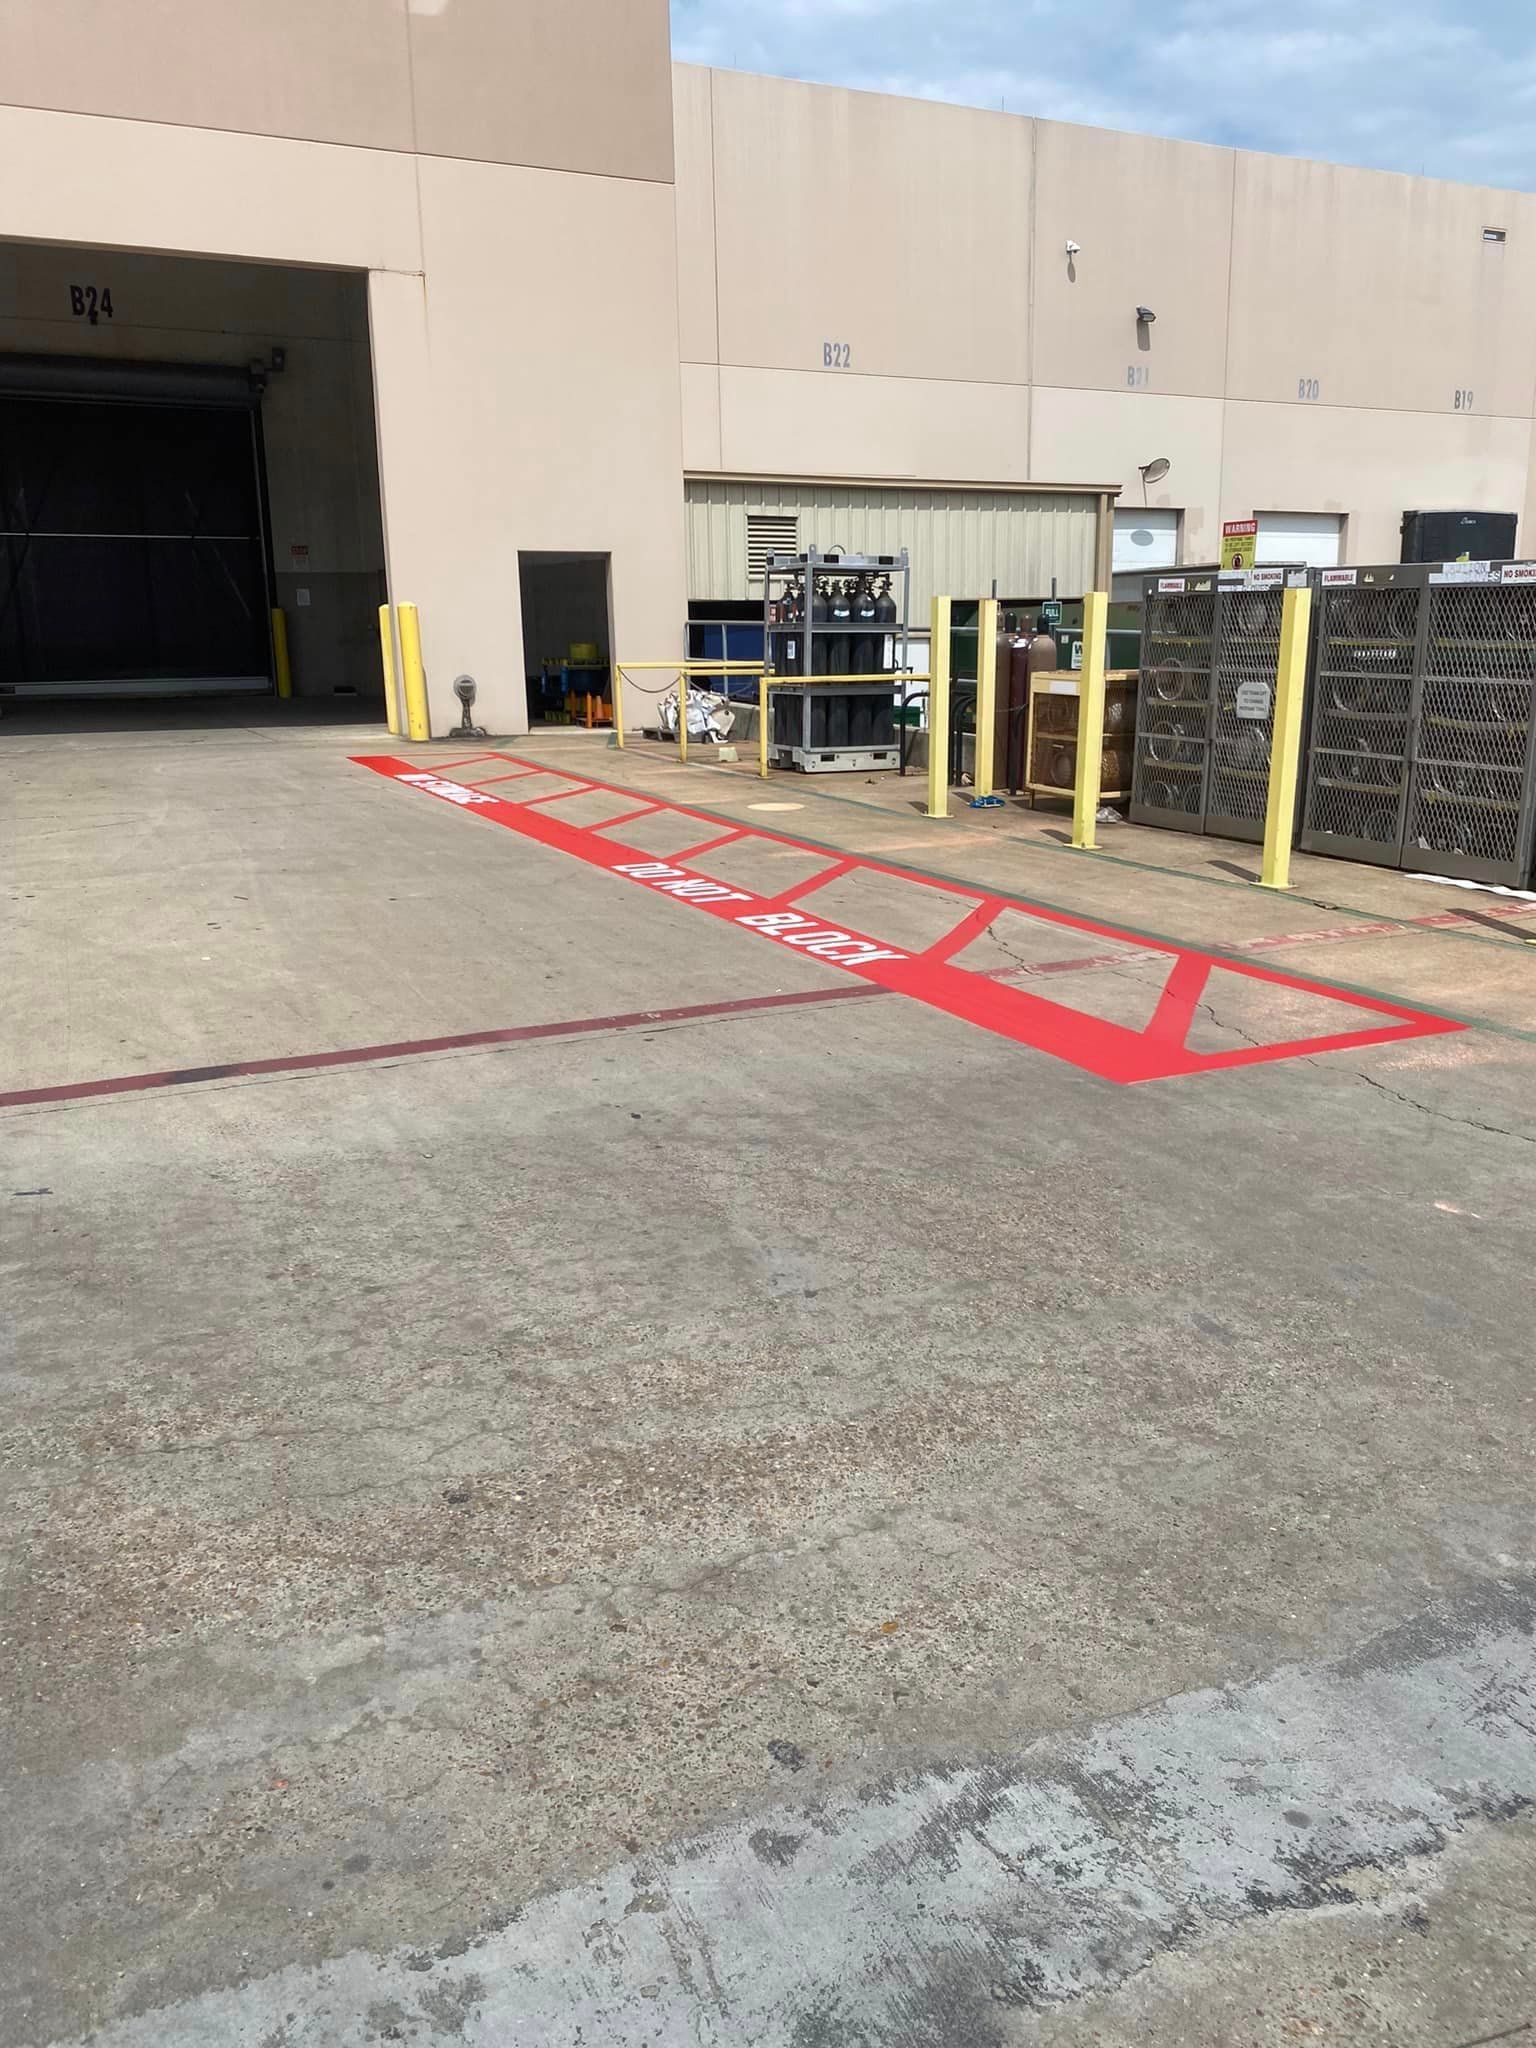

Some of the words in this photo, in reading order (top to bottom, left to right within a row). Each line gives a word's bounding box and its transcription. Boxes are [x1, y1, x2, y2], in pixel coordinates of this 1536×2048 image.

[70, 285, 113, 319] B24
[824, 342, 850, 368] B22
[1127, 366, 1149, 385] B21
[1298, 378, 1319, 400] B20
[1454, 389, 1473, 410] B19
[1224, 522, 1256, 534] WARNING
[1504, 569, 1513, 578] NO
[611, 862, 686, 879] DO
[652, 879, 754, 903] NOT
[734, 912, 910, 966] BLOCK
